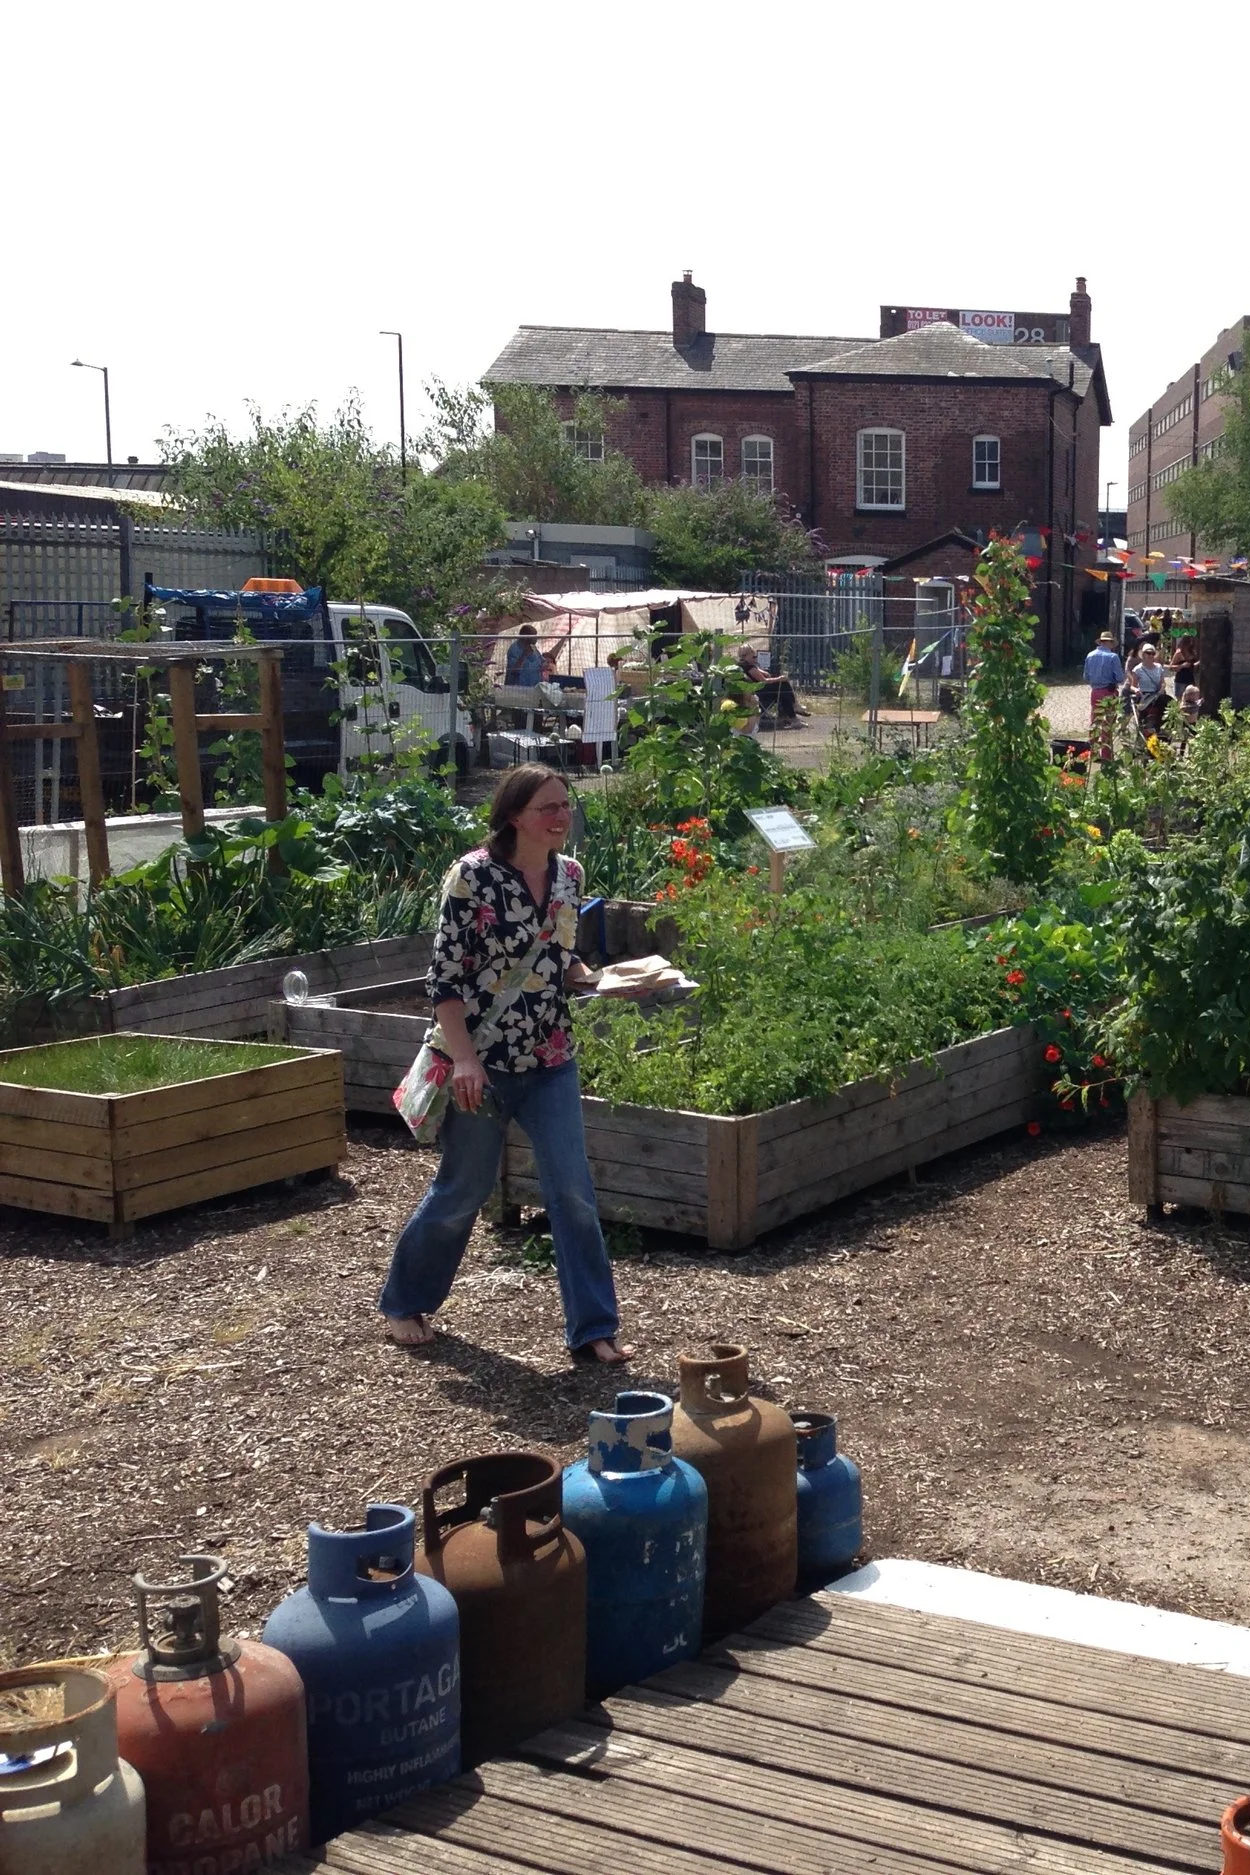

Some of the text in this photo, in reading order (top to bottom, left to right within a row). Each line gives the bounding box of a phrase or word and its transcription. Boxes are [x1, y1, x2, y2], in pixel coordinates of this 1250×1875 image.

[908, 310, 946, 320] TO LET
[961, 313, 1013, 327] LOOK!
[380, 1704, 447, 1745] BUTANE
[347, 1763, 396, 1785] HIGHLY
[169, 1783, 284, 1846] CALOR
